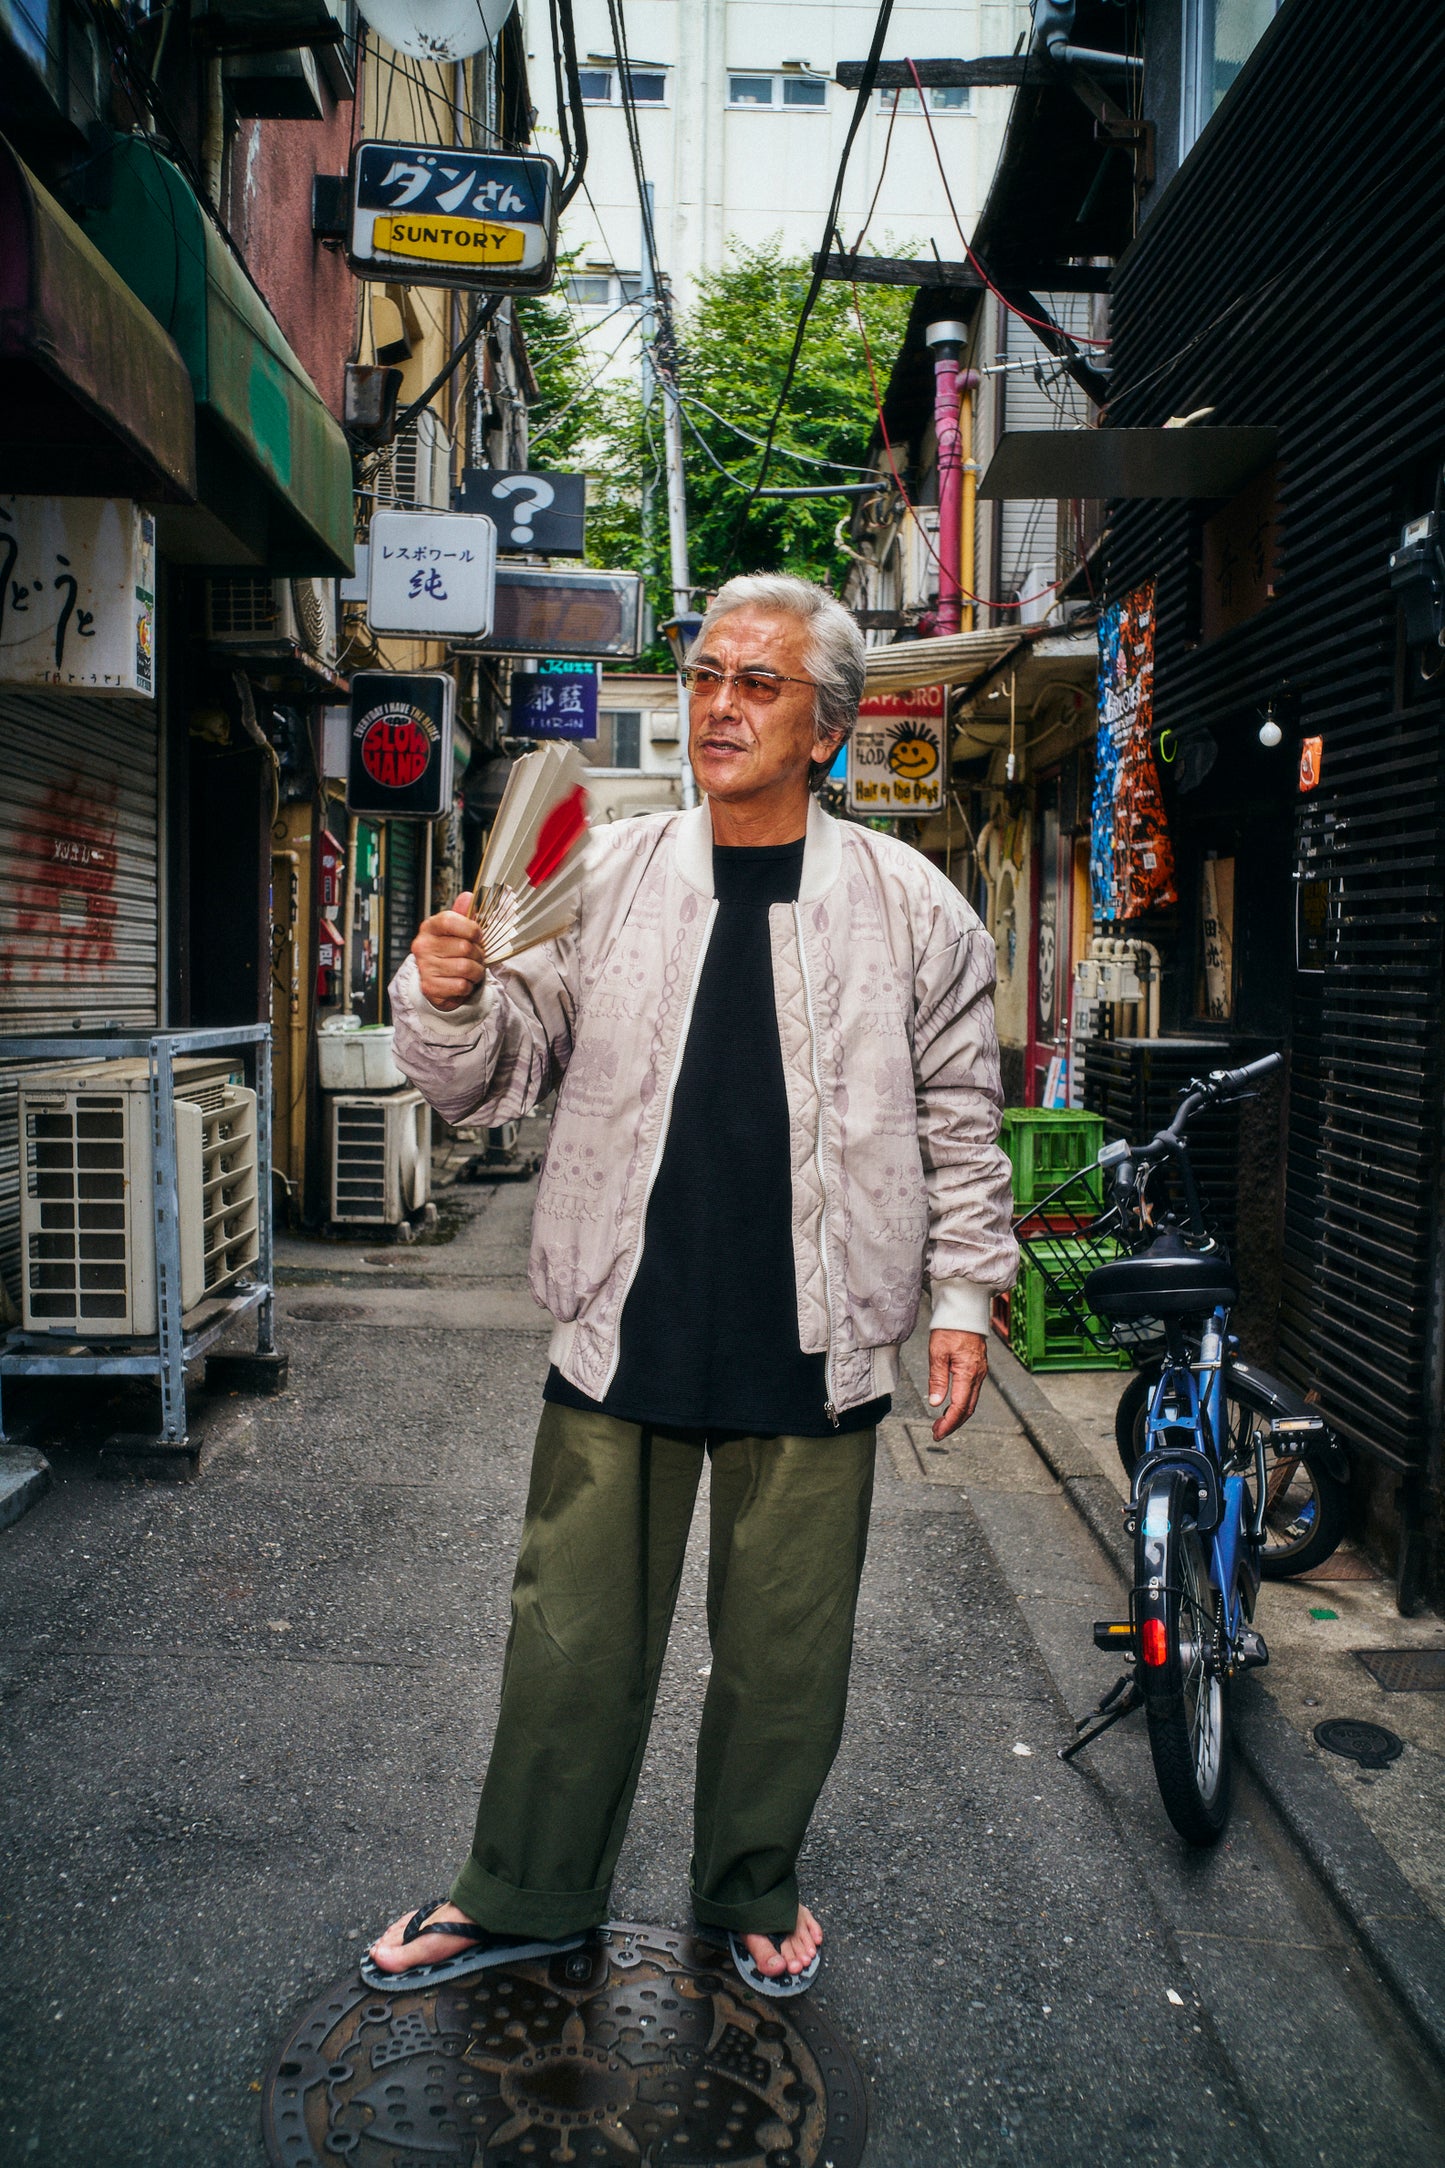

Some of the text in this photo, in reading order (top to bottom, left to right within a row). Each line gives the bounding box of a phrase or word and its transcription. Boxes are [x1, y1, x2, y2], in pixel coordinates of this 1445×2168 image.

[380, 155, 527, 213] ダンさん
[392, 224, 508, 250] SUNTORY
[382, 546, 475, 562] レスポワール
[408, 568, 448, 600] 純
[353, 702, 441, 742] EVERYDAY I HAVE THE BLUES
[364, 719, 428, 753] SLOW
[363, 751, 427, 787] HAND
[856, 780, 877, 801] Hair
[894, 780, 911, 803] the
[914, 780, 939, 805] Dogs
